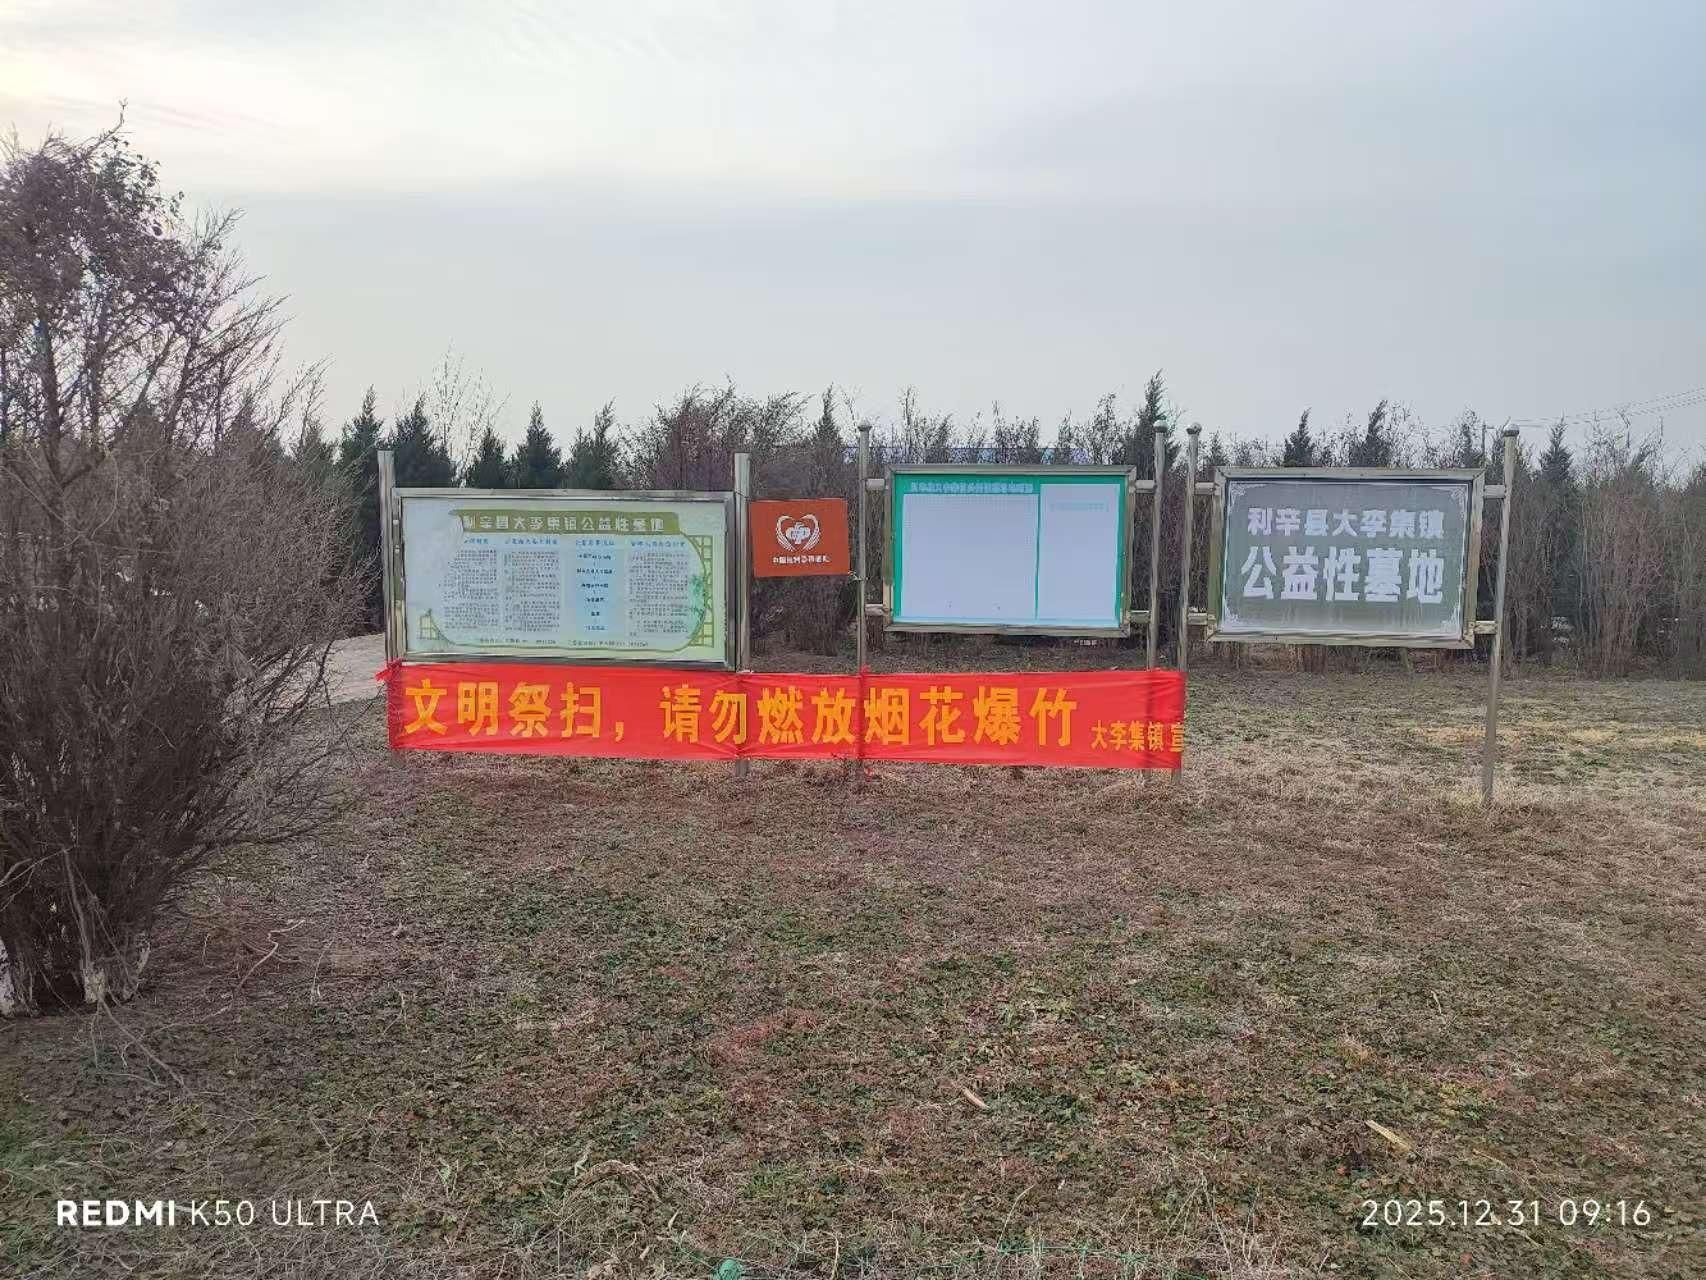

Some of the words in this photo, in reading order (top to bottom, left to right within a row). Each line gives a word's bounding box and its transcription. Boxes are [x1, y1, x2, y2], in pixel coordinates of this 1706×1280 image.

[1247, 507, 1445, 539] 利辛县大李集镇
[1240, 546, 1446, 604] 公益性墓地
